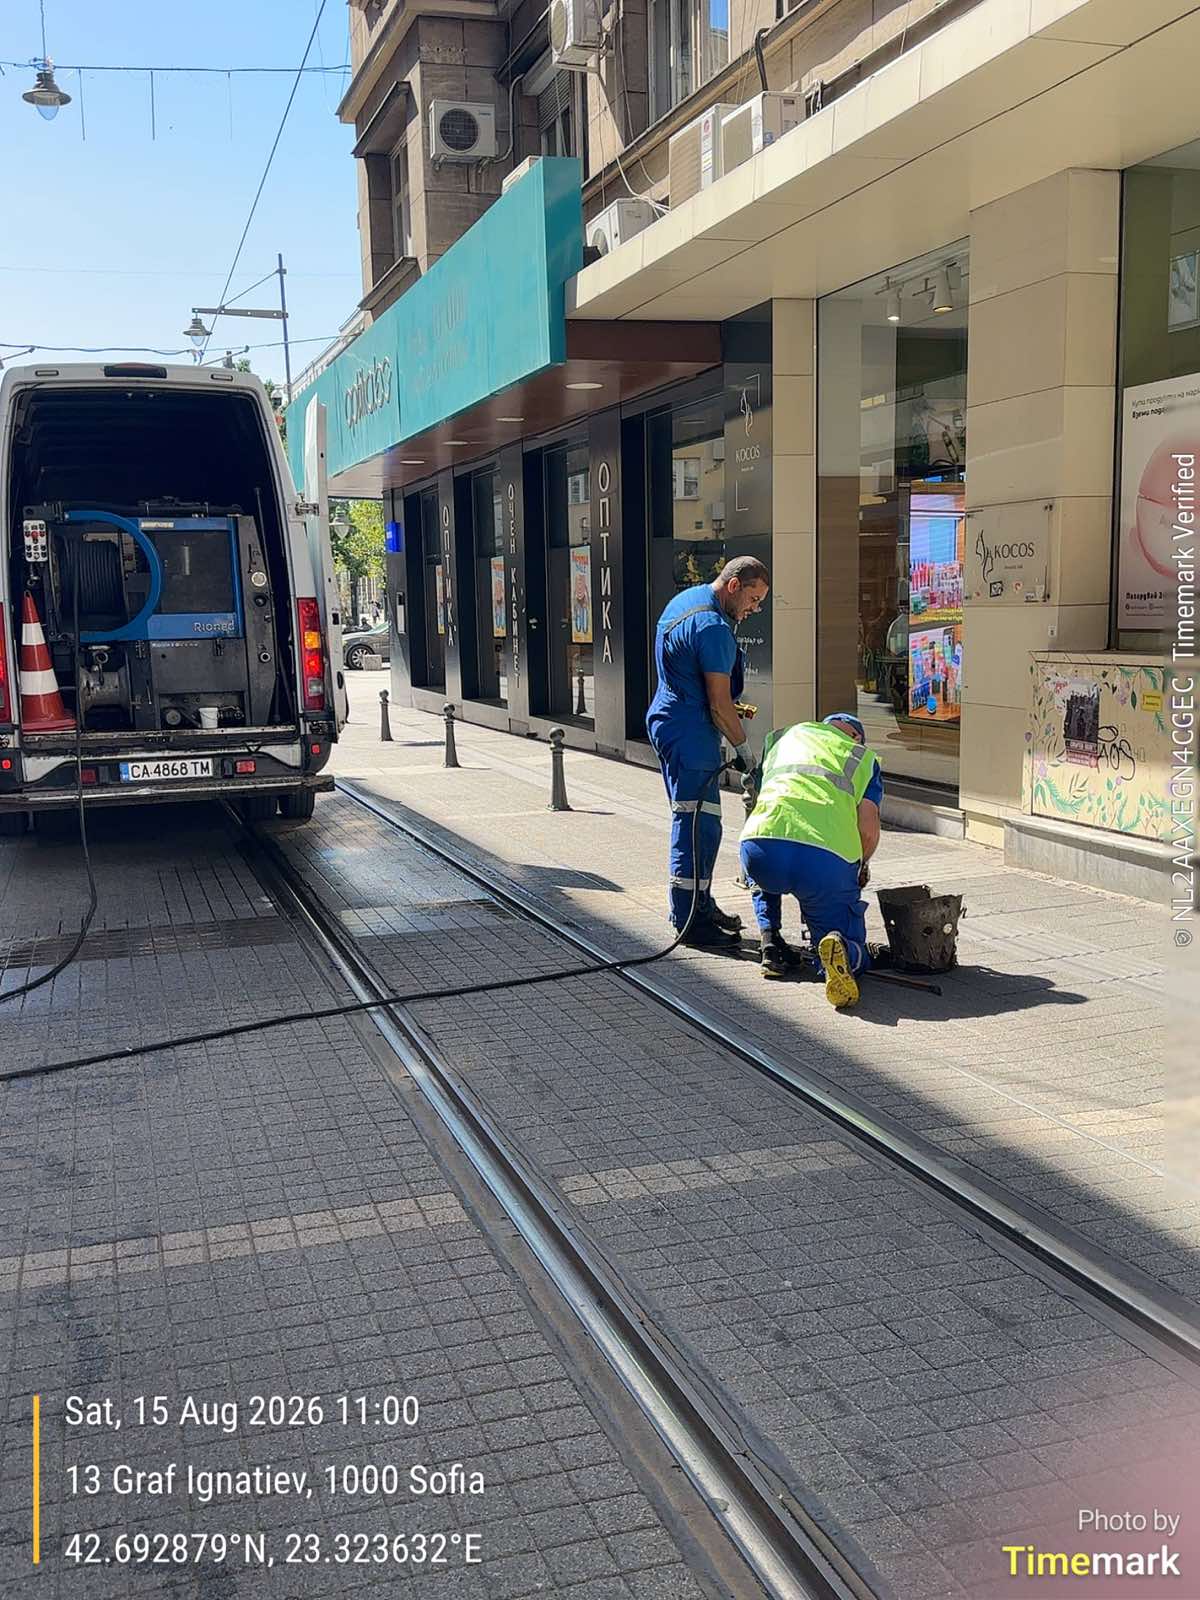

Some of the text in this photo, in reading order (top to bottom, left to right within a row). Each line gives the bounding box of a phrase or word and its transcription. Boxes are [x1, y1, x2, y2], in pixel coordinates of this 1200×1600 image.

[735, 444, 760, 463] KOCOS
[442, 506, 455, 647] ОПТИКА
[507, 483, 521, 689] ОЧЕН КАБИНЕТ
[598, 462, 614, 664] ОПТИКА
[994, 542, 1034, 559] KOCOS
[193, 620, 235, 632] Rioned
